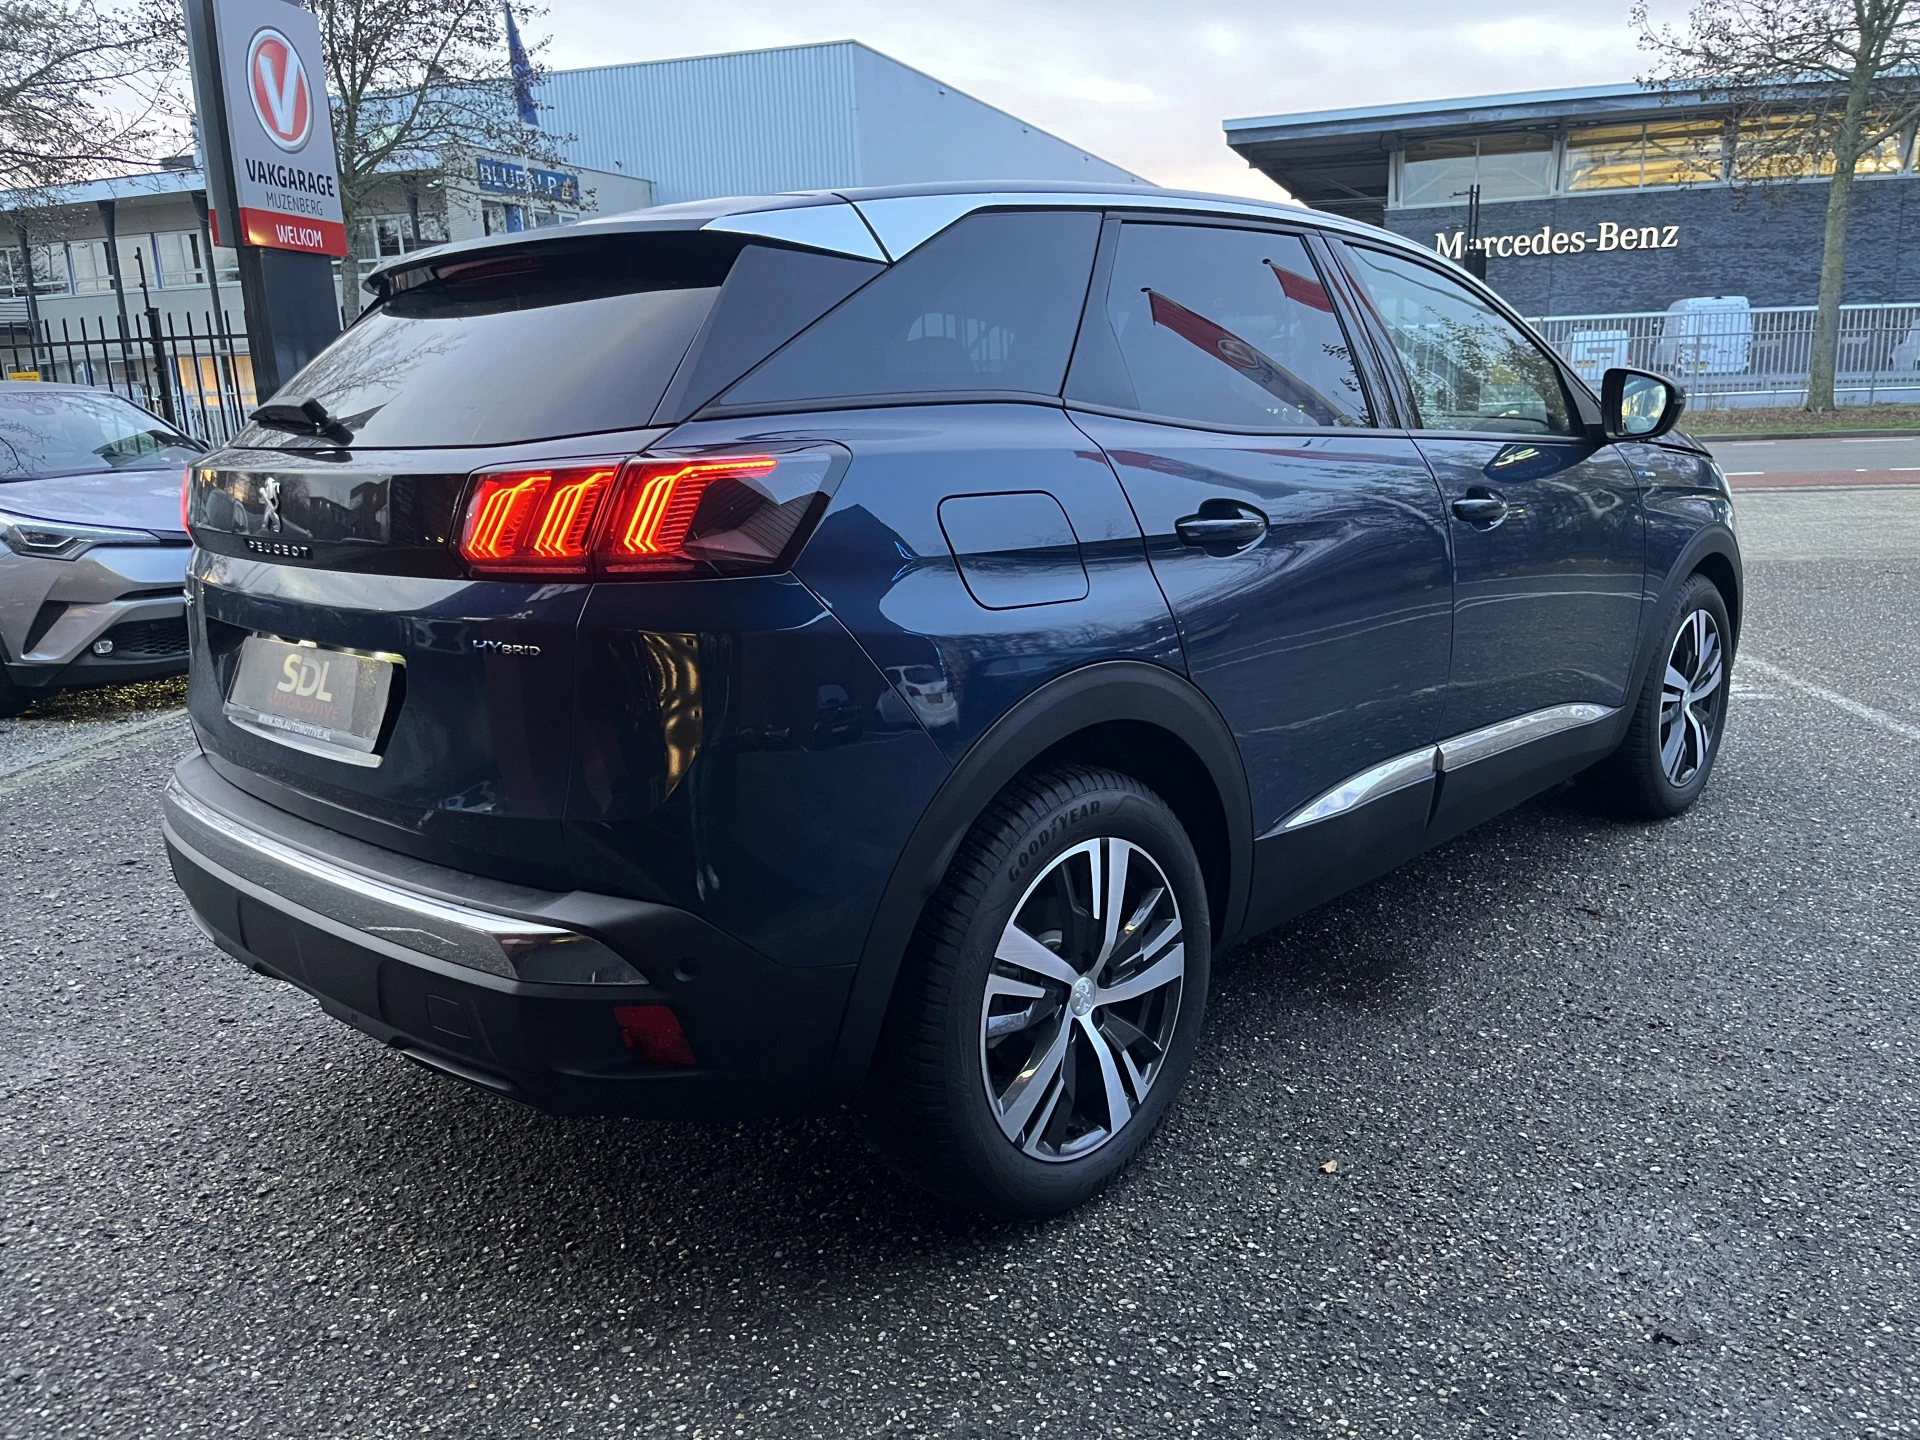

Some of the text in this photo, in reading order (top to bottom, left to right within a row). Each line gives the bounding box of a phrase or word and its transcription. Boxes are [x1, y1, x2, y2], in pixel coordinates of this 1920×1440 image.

[246, 158, 335, 197] VAKGARAGE
[266, 191, 323, 216] MUZENBERG
[276, 224, 323, 248] WELKOM
[248, 540, 308, 557] PEUGEOT
[472, 640, 541, 656] HYBRID
[276, 653, 332, 702] SDL
[266, 690, 340, 720] AUTOMOTIVE
[258, 713, 331, 741] WWW.SDLAUTOMOTIVE.NL
[1008, 800, 1100, 882] GOODYEAR
